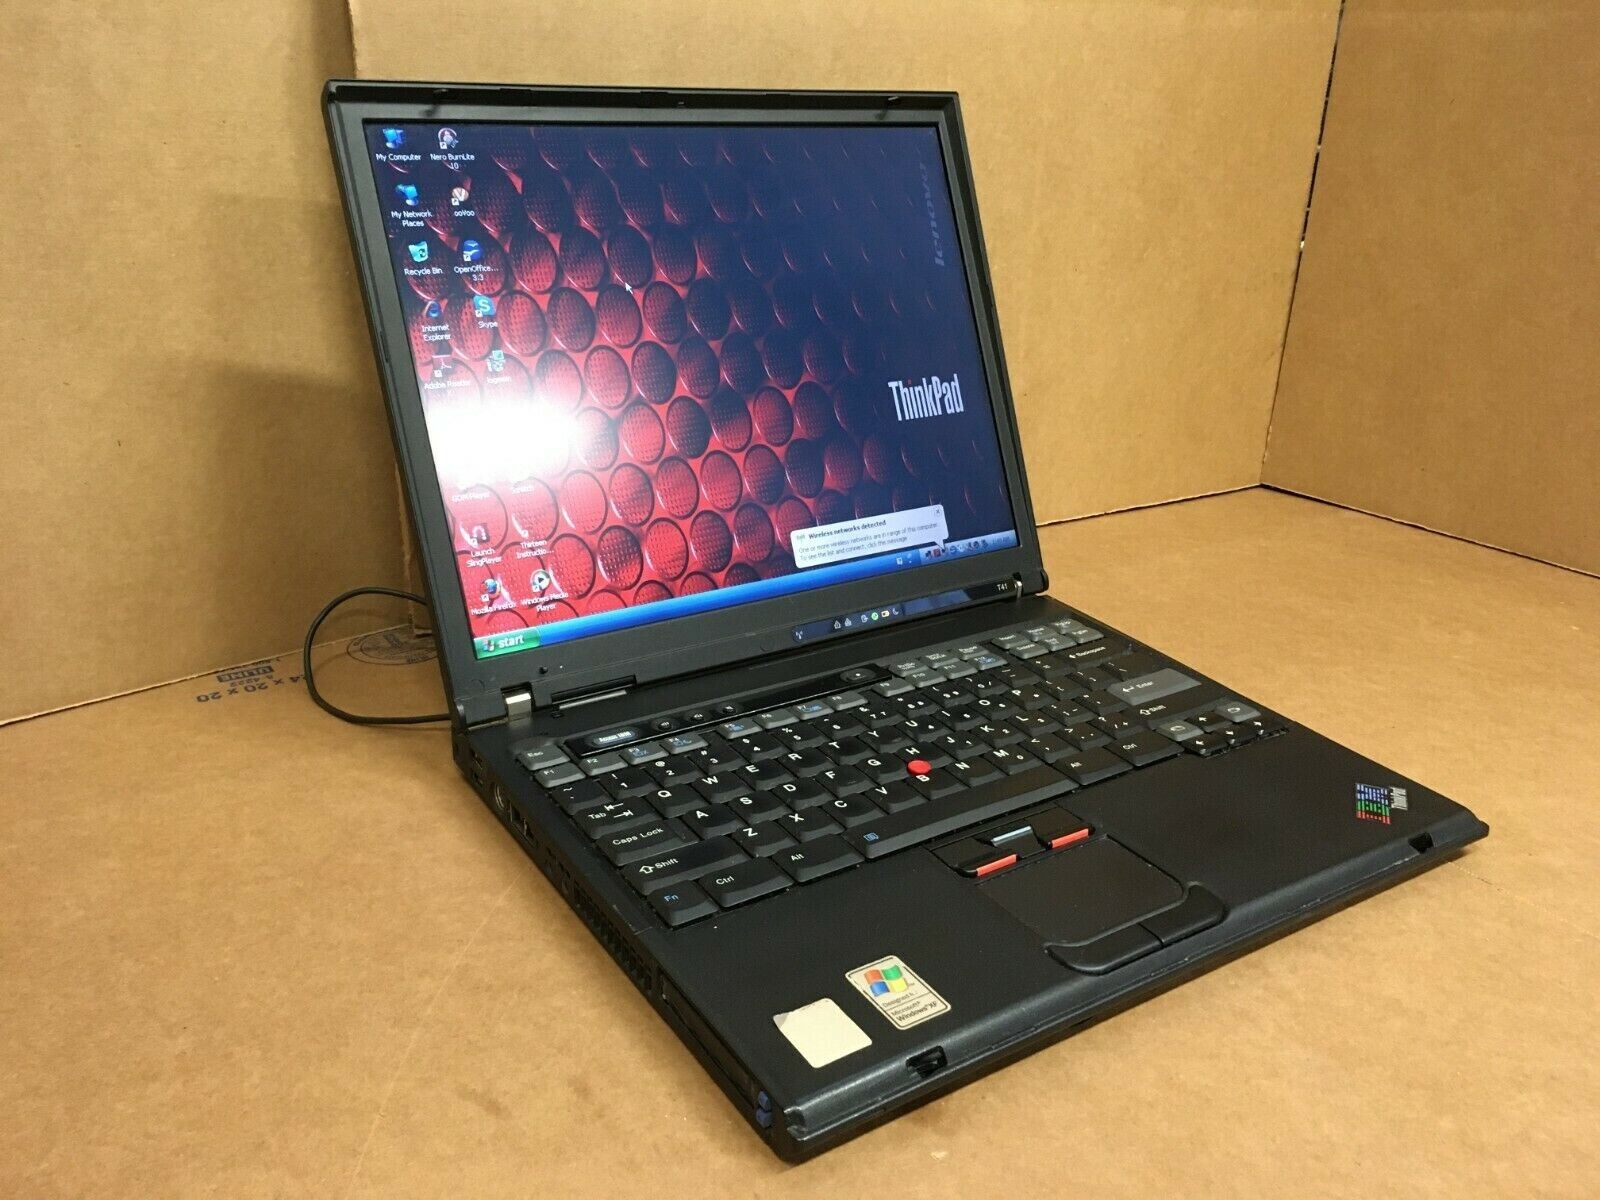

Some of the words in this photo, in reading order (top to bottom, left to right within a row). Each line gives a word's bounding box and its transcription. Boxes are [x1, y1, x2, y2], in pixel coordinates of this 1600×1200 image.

[376, 153, 387, 162] My
[388, 153, 422, 162] Computer
[391, 211, 402, 219] My
[403, 210, 433, 218] Network
[402, 220, 425, 228] Places
[404, 268, 431, 276] Recycle
[422, 324, 450, 332] Internet
[478, 320, 498, 329] Skype
[888, 373, 965, 422] ThinkPad
[808, 530, 833, 540] Wireless
[834, 525, 861, 536] networks
[862, 520, 887, 530] detected
[498, 634, 525, 649] start
[244, 681, 269, 693] 20
[196, 690, 223, 703] 20
[980, 724, 995, 732] K
[868, 730, 879, 738] Y
[828, 741, 840, 749] T
[527, 750, 544, 758] Esc
[906, 747, 920, 755] H
[993, 749, 1010, 758] M
[788, 752, 802, 761] R
[867, 758, 882, 766] G
[955, 761, 970, 770] N
[745, 764, 760, 774] E
[824, 770, 836, 780] F
[916, 774, 930, 782] B
[701, 776, 719, 786] W
[783, 784, 796, 792] D
[875, 786, 888, 796] V
[657, 790, 672, 798] Q
[740, 797, 752, 805] S
[834, 800, 848, 808] C
[588, 812, 607, 820] Tab
[696, 810, 710, 820] A
[788, 813, 804, 822] X
[612, 834, 638, 846] Caps
[640, 827, 664, 838] Lock
[743, 828, 758, 837] Z
[790, 852, 805, 862] Alt
[654, 857, 679, 869] Shift
[716, 875, 736, 886] Ctrl
[664, 893, 679, 902] Fn
